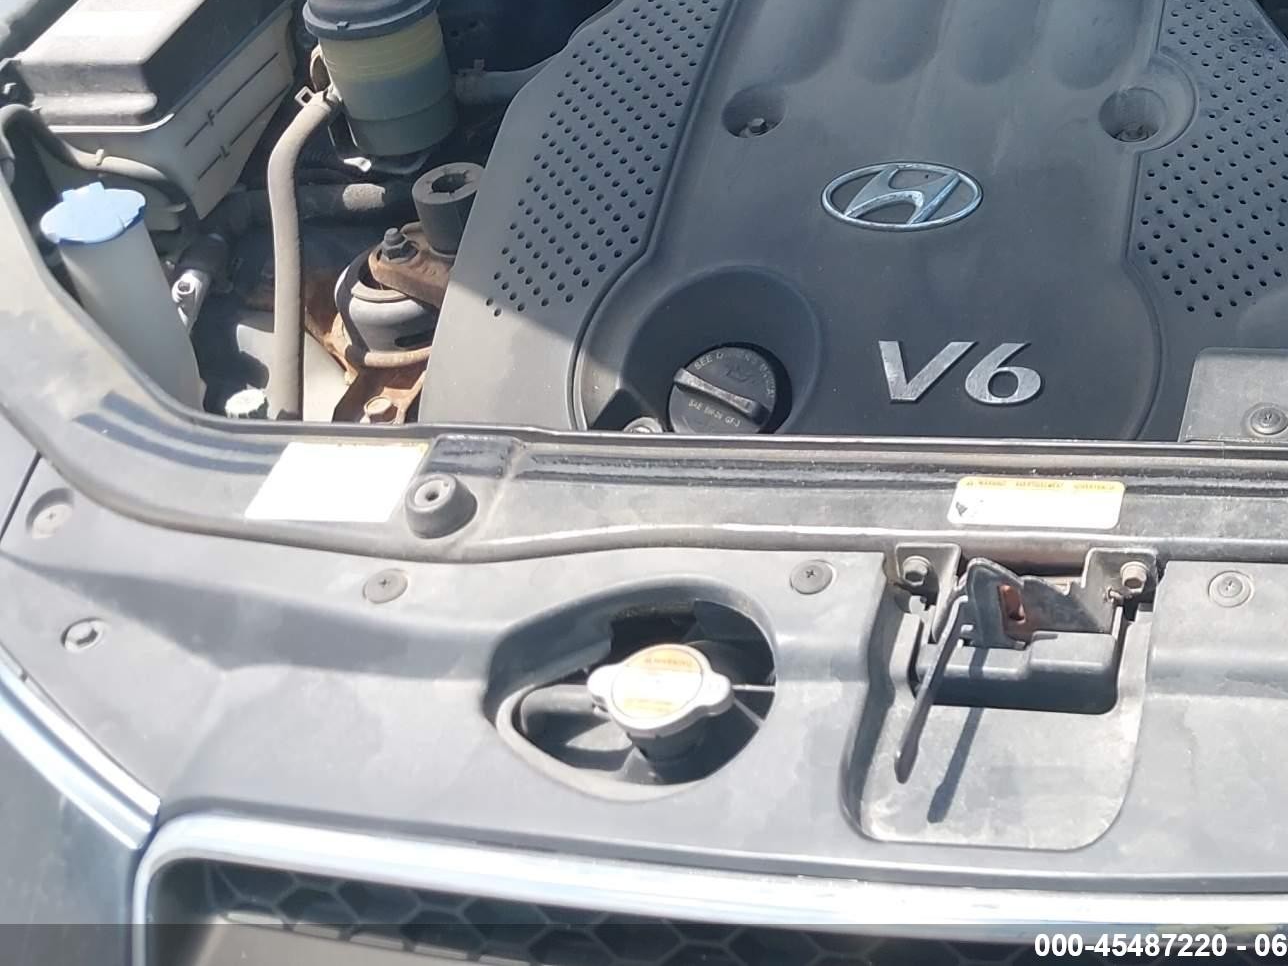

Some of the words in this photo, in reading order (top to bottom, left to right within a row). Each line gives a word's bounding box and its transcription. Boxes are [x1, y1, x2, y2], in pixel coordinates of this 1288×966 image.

[208, 109, 215, 126] F
[220, 145, 231, 158] L
[694, 353, 713, 370] SEE
[878, 340, 1042, 405] V6
